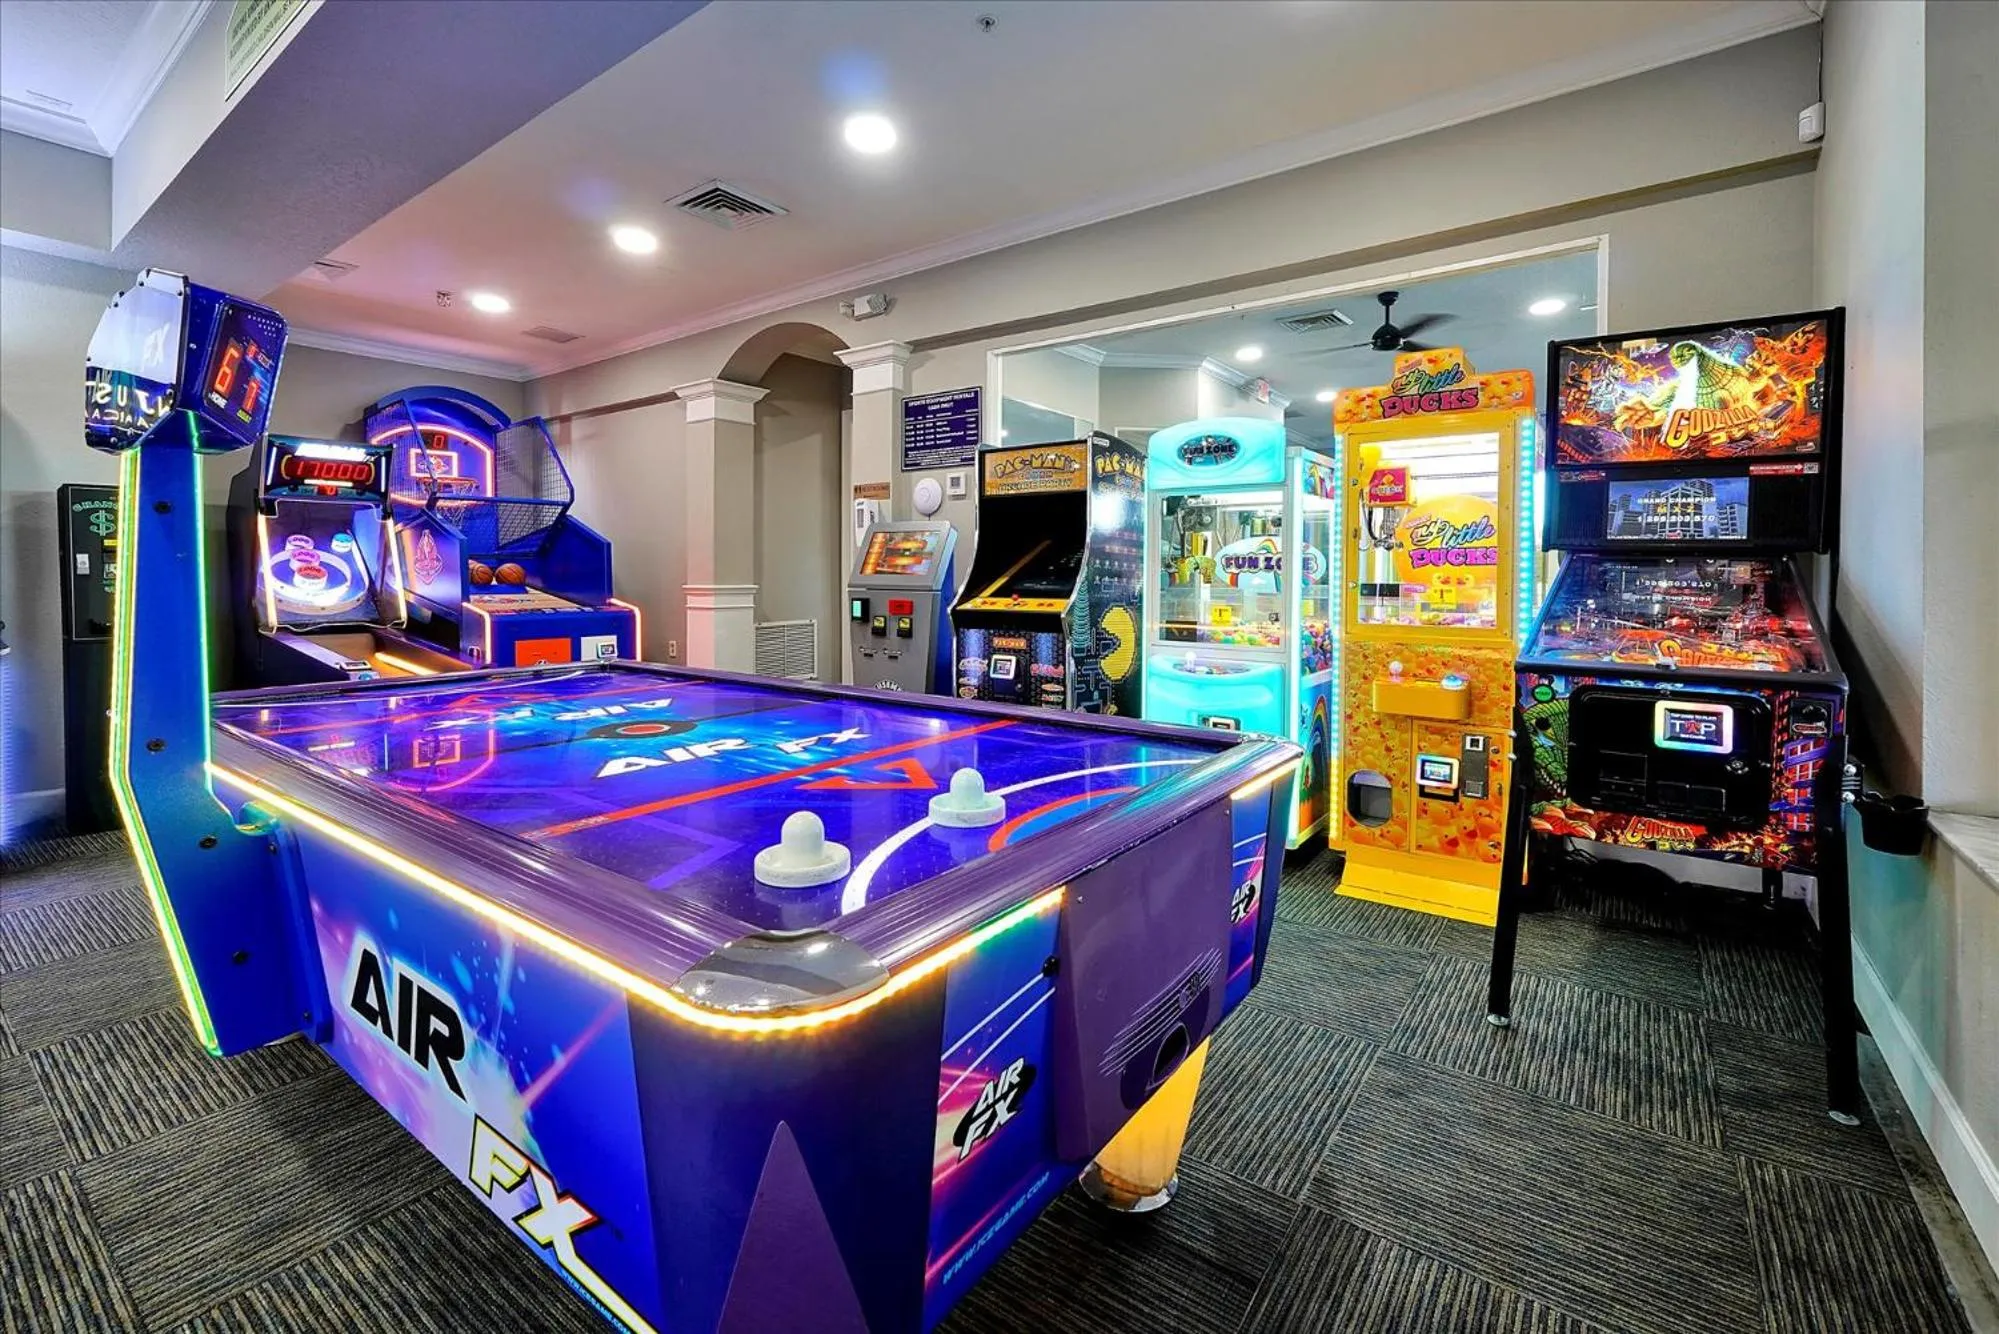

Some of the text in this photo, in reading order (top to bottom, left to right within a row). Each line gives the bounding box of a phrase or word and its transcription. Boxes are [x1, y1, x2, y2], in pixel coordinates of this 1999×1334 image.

[1380, 387, 1479, 418] DUCKS
[1666, 404, 1758, 448] GODZILLA
[1095, 453, 1146, 478] PAC-MA
[1225, 556, 1260, 570] FUN
[596, 727, 873, 778] AIR FX
[350, 948, 468, 1103] AIR
[973, 1058, 1024, 1118] AIR
[960, 1088, 1018, 1160] FX
